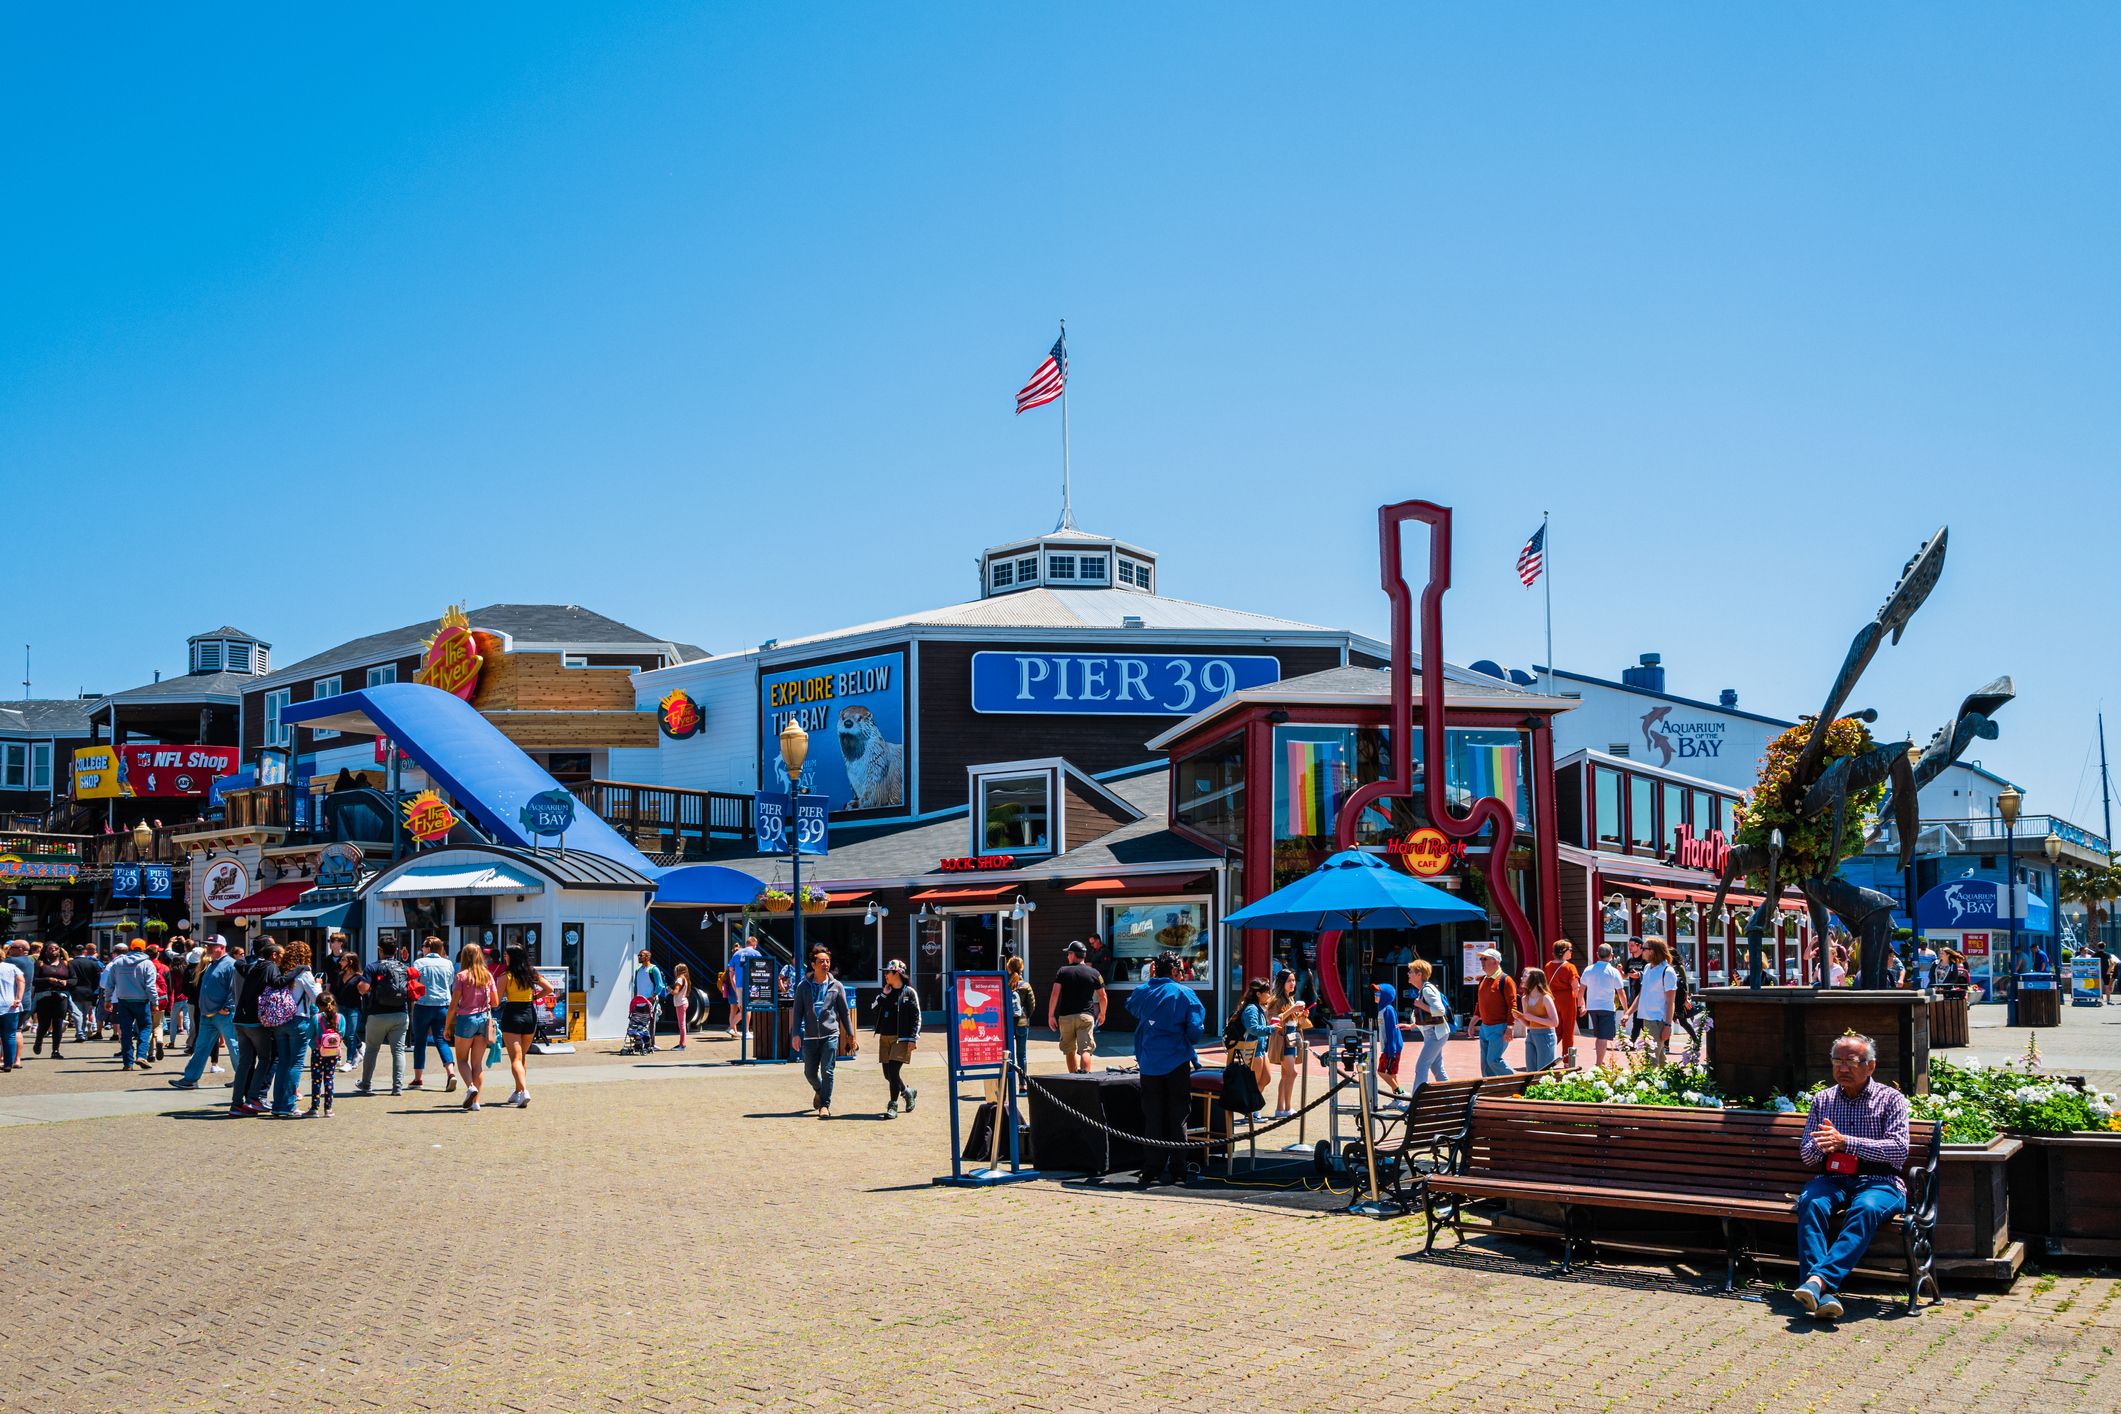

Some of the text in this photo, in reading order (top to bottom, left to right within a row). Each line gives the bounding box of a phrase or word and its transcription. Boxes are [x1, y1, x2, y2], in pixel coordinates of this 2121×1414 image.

[771, 666, 889, 707] EXPLORE BELOW
[1015, 657, 1236, 711] PIER 39
[677, 704, 694, 716] The
[668, 710, 694, 728] Flyer
[801, 706, 827, 732] BAY
[1661, 721, 1725, 736] AQUARIUM
[1678, 738, 1723, 757] BAY
[76, 756, 108, 771] COLLEGE
[154, 752, 183, 767] NFL
[188, 752, 228, 771] Shop
[80, 775, 99, 789] SHOP
[529, 803, 569, 812] AQUARIUM
[760, 803, 782, 815] PIER
[798, 806, 823, 817] PIER
[540, 813, 567, 825] BAY
[760, 816, 782, 841] 39
[798, 818, 825, 843] 39
[1387, 838, 1467, 858] Hard Rock
[1675, 824, 1714, 868] Hard
[941, 856, 1011, 871] ROCK SHOP
[150, 869, 168, 877] PIER
[115, 876, 137, 891] 39
[150, 877, 169, 891] 39
[1956, 893, 1996, 901] AQUARIUM
[1966, 901, 1994, 913] BAY
